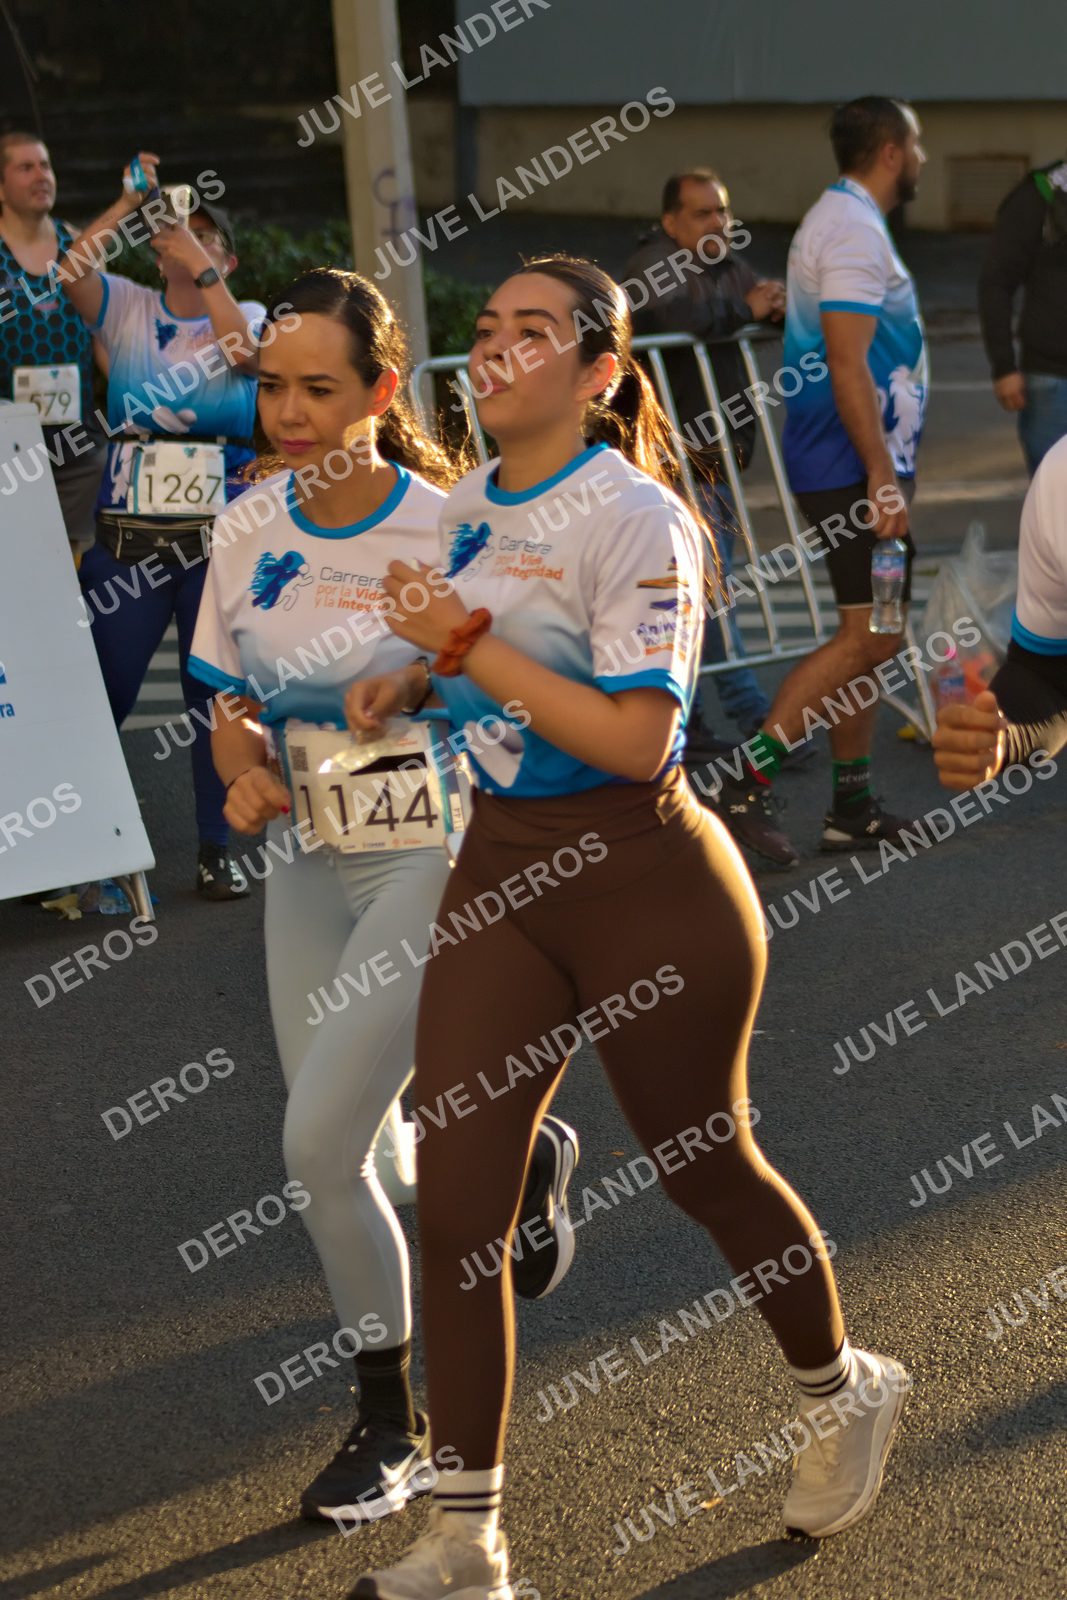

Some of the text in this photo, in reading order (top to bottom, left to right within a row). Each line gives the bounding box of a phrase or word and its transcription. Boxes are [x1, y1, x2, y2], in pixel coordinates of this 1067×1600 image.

[30, 391, 71, 417] 579
[144, 473, 222, 505] 1267
[319, 566, 385, 588] Carrera
[299, 778, 438, 836] 1144
